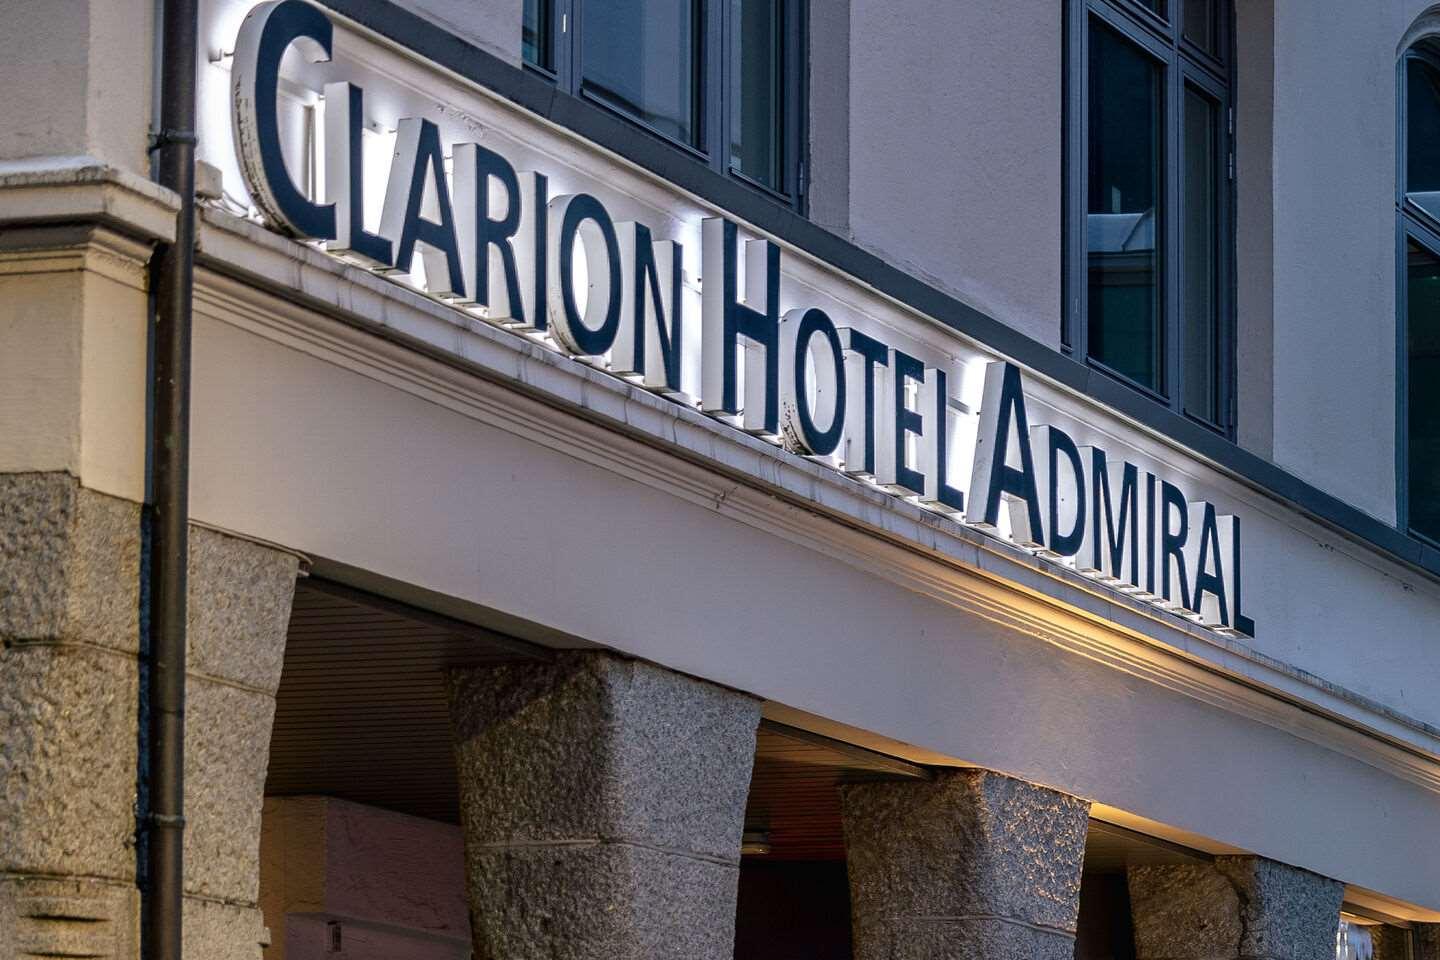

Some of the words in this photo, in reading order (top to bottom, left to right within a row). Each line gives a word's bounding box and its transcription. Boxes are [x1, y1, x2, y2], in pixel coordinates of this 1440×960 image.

[233, 0, 683, 393] CLARION
[702, 217, 964, 512] HOTEL
[968, 361, 1255, 638] ADMIRAL
